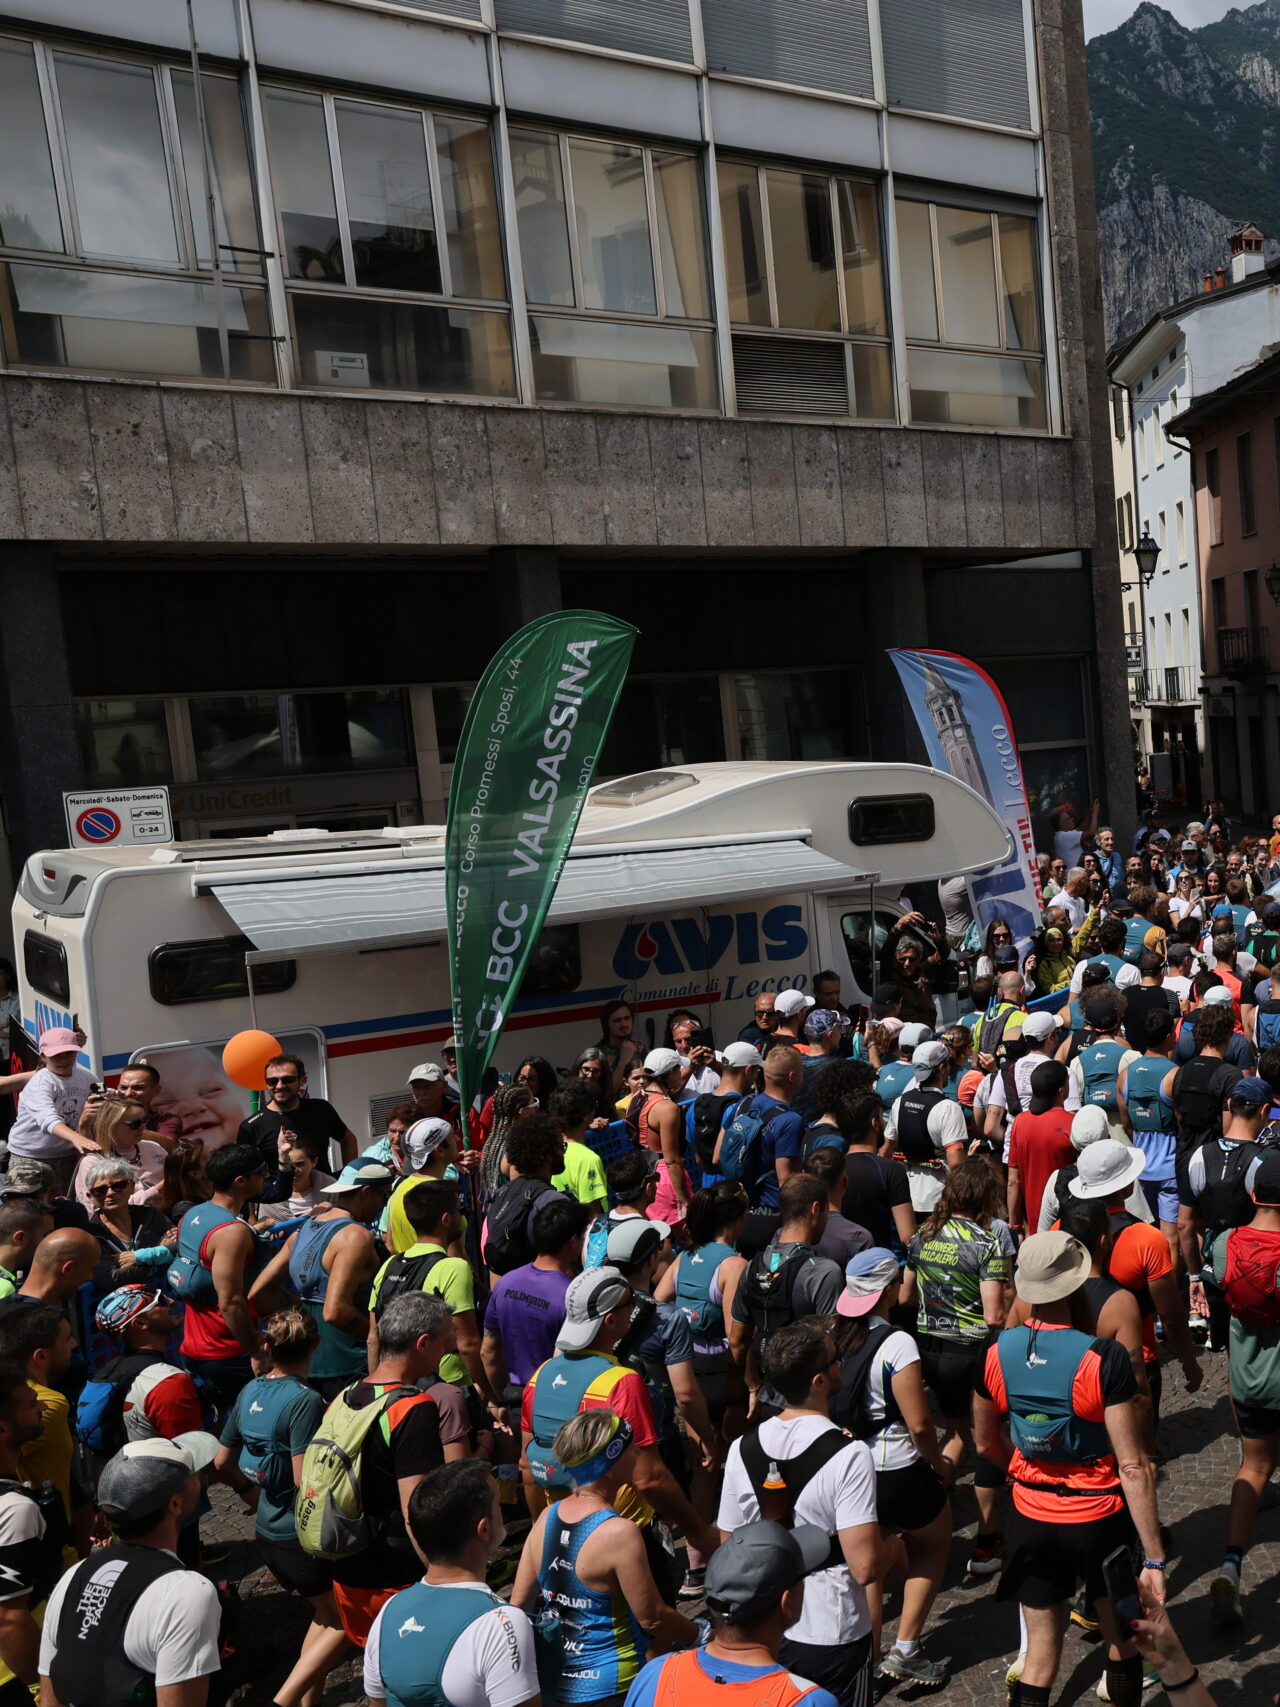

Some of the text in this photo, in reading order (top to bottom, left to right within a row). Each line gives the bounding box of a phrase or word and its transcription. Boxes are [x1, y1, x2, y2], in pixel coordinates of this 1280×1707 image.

[460, 825, 481, 873] Corso
[471, 737, 502, 818] Promessi
[491, 686, 519, 735] Sposi,
[506, 657, 524, 681] 44
[992, 723, 1026, 811] Lecco
[190, 786, 295, 812] UniCredit
[486, 640, 599, 982] BCC VALSASSINA
[612, 905, 809, 981] AVIS
[618, 973, 808, 1003] Comunale di Lecco
[920, 1249, 960, 1267] VALCALEPIO
[923, 1240, 959, 1255] RUNNERS
[300, 1499, 317, 1532] reseg
[76, 1582, 95, 1613] THE
[78, 1585, 104, 1640] NORTH
[91, 1588, 112, 1627] FACE
[503, 1620, 521, 1673] BIONIC
